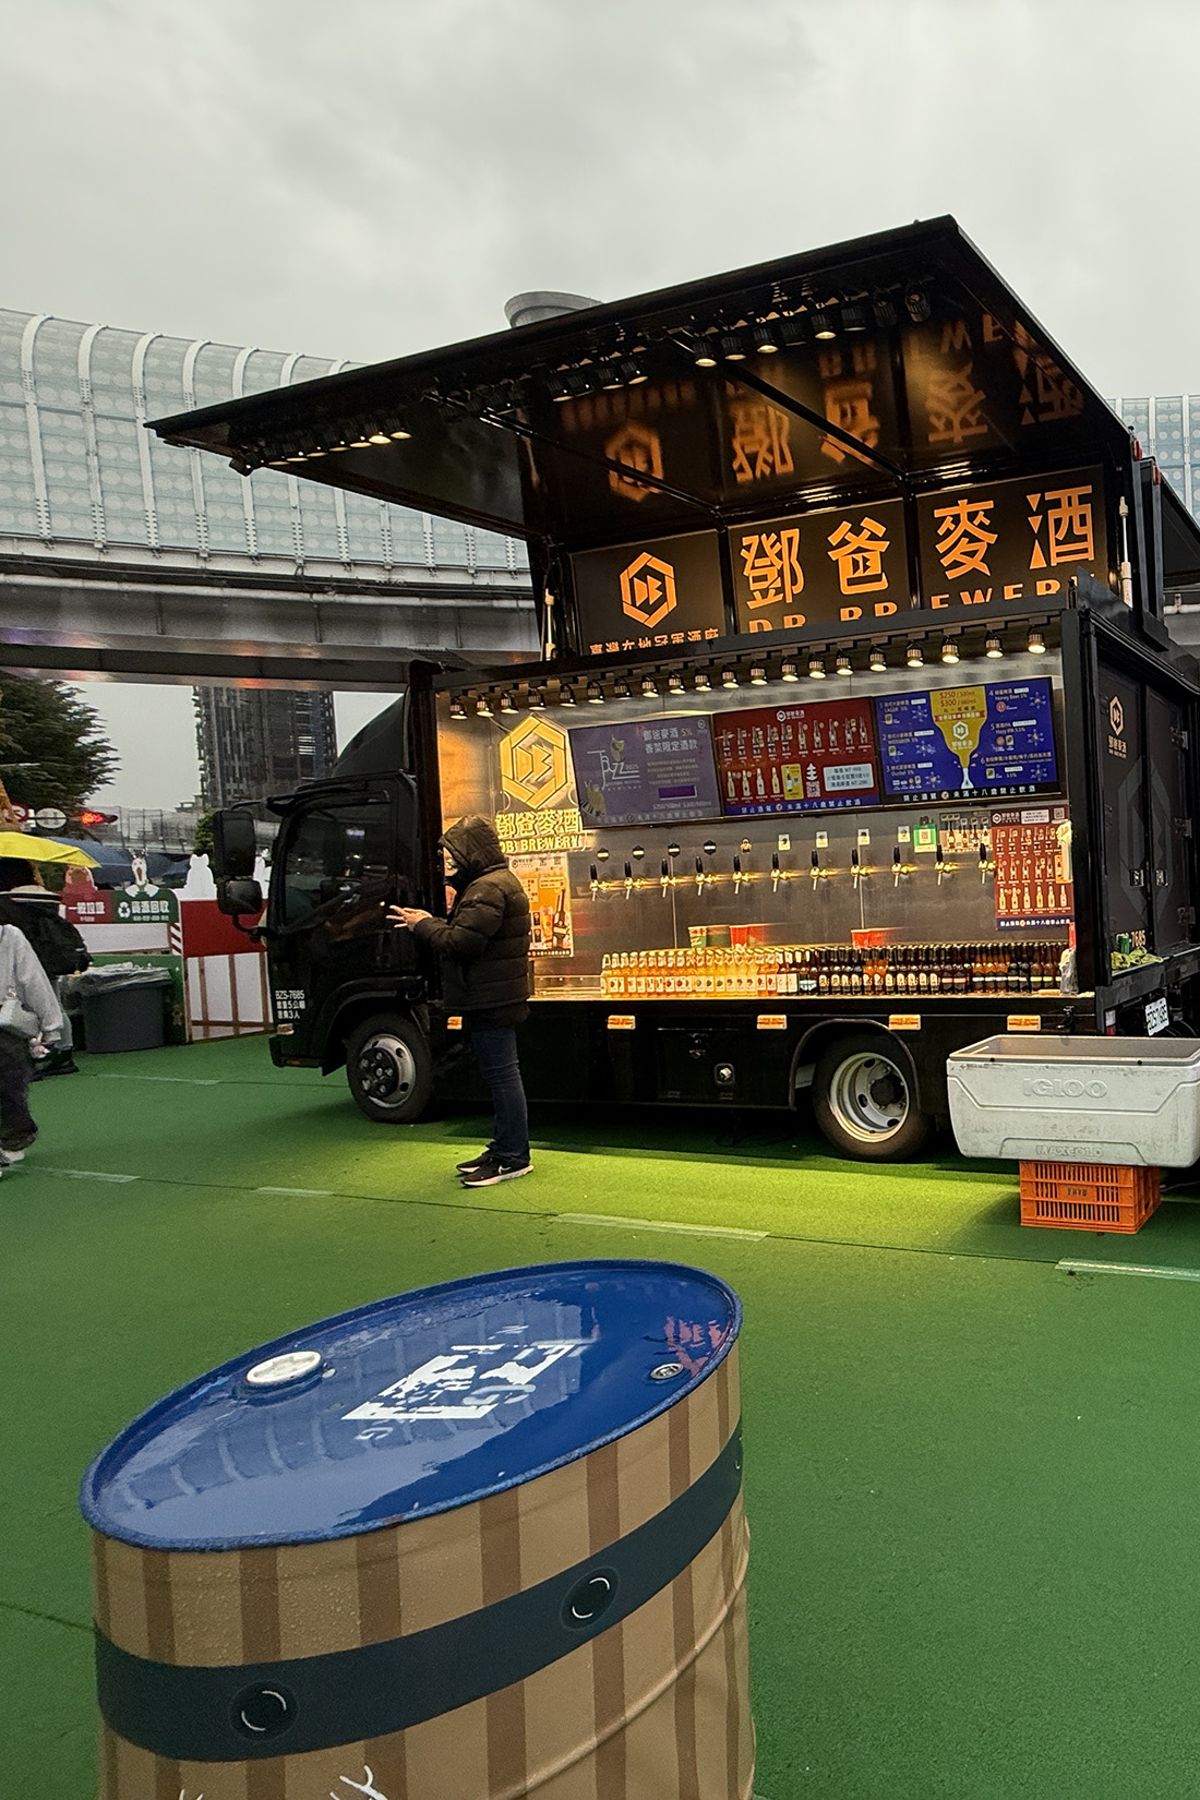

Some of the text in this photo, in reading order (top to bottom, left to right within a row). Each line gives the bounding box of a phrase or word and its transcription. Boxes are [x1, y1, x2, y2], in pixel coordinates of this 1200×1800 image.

[740, 485, 1095, 609] 鄧爸麥酒
[521, 835, 580, 851] BREWERY
[1023, 1078, 1108, 1098] IGLOO
